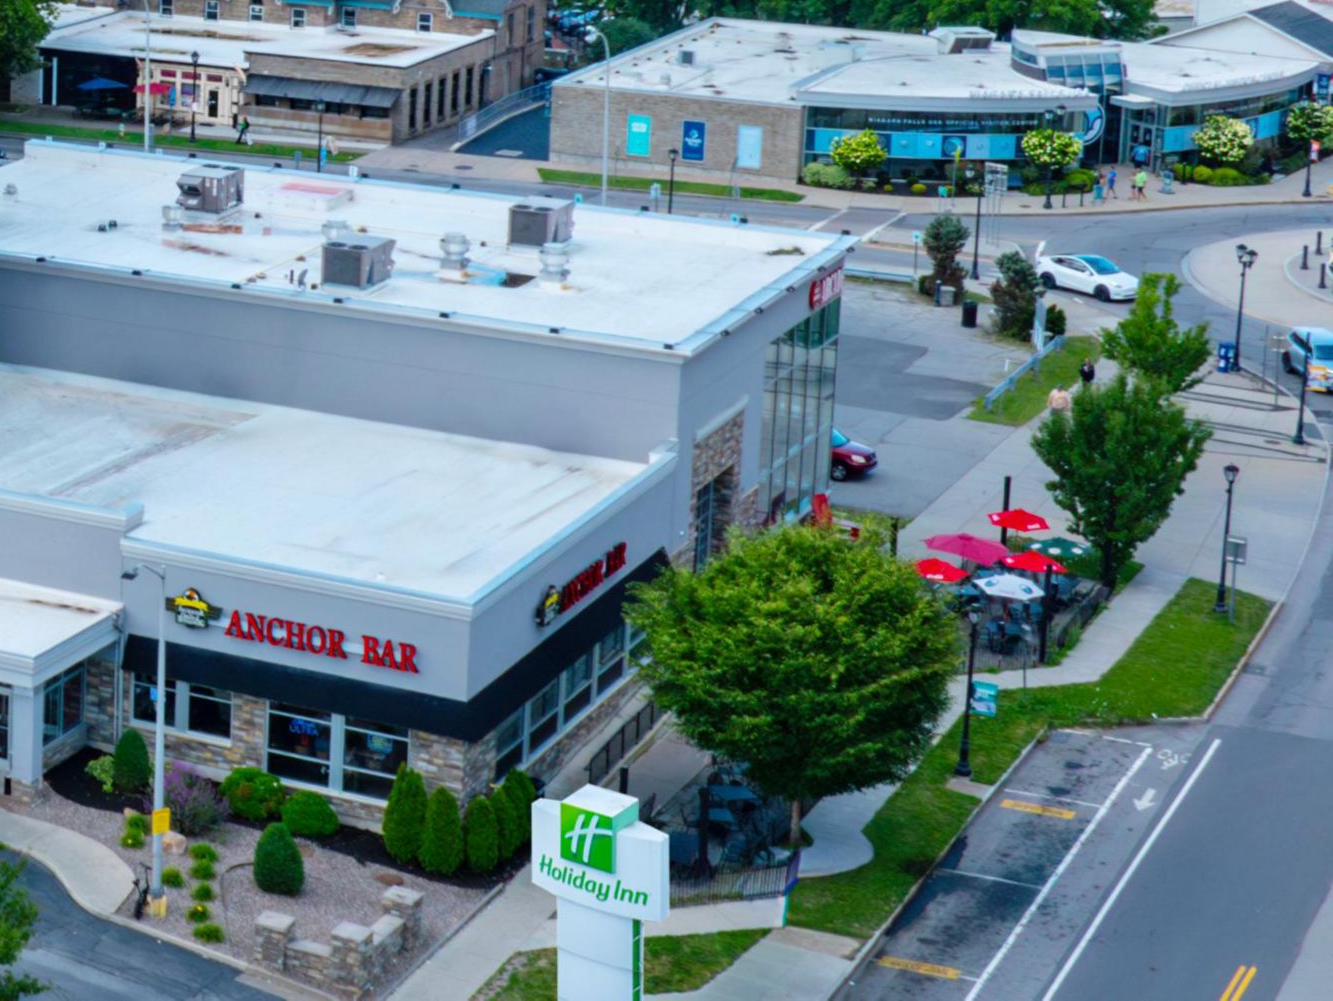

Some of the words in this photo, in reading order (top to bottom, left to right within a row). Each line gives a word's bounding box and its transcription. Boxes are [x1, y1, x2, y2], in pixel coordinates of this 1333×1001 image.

[224, 610, 347, 660] ANCHOR
[361, 635, 419, 674] BAR
[289, 724, 319, 737] ULTRA
[539, 854, 611, 902] Holiday
[613, 879, 649, 906] Inn
